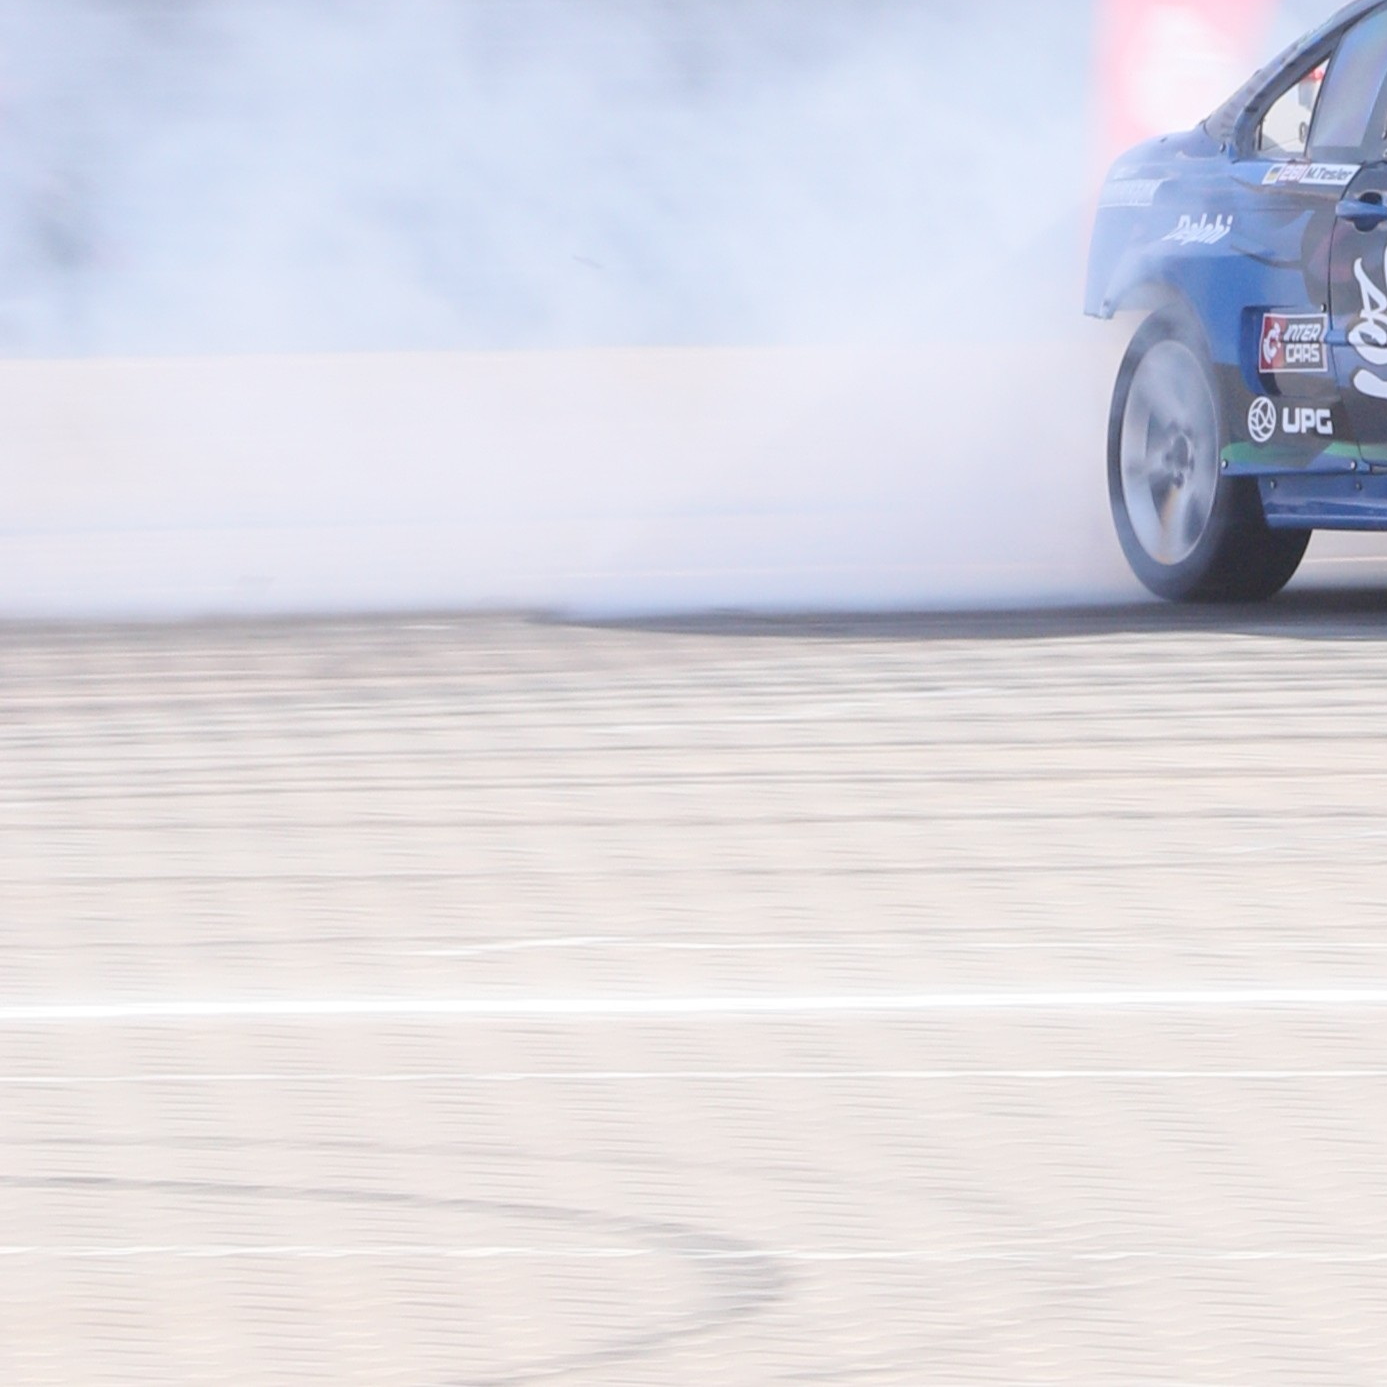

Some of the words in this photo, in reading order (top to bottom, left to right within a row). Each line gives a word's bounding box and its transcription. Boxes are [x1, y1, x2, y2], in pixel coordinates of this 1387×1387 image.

[1161, 212, 1233, 245] Delphi
[1283, 323, 1321, 342] INTER
[1285, 343, 1320, 363] CARS
[1282, 407, 1333, 434] UPG
